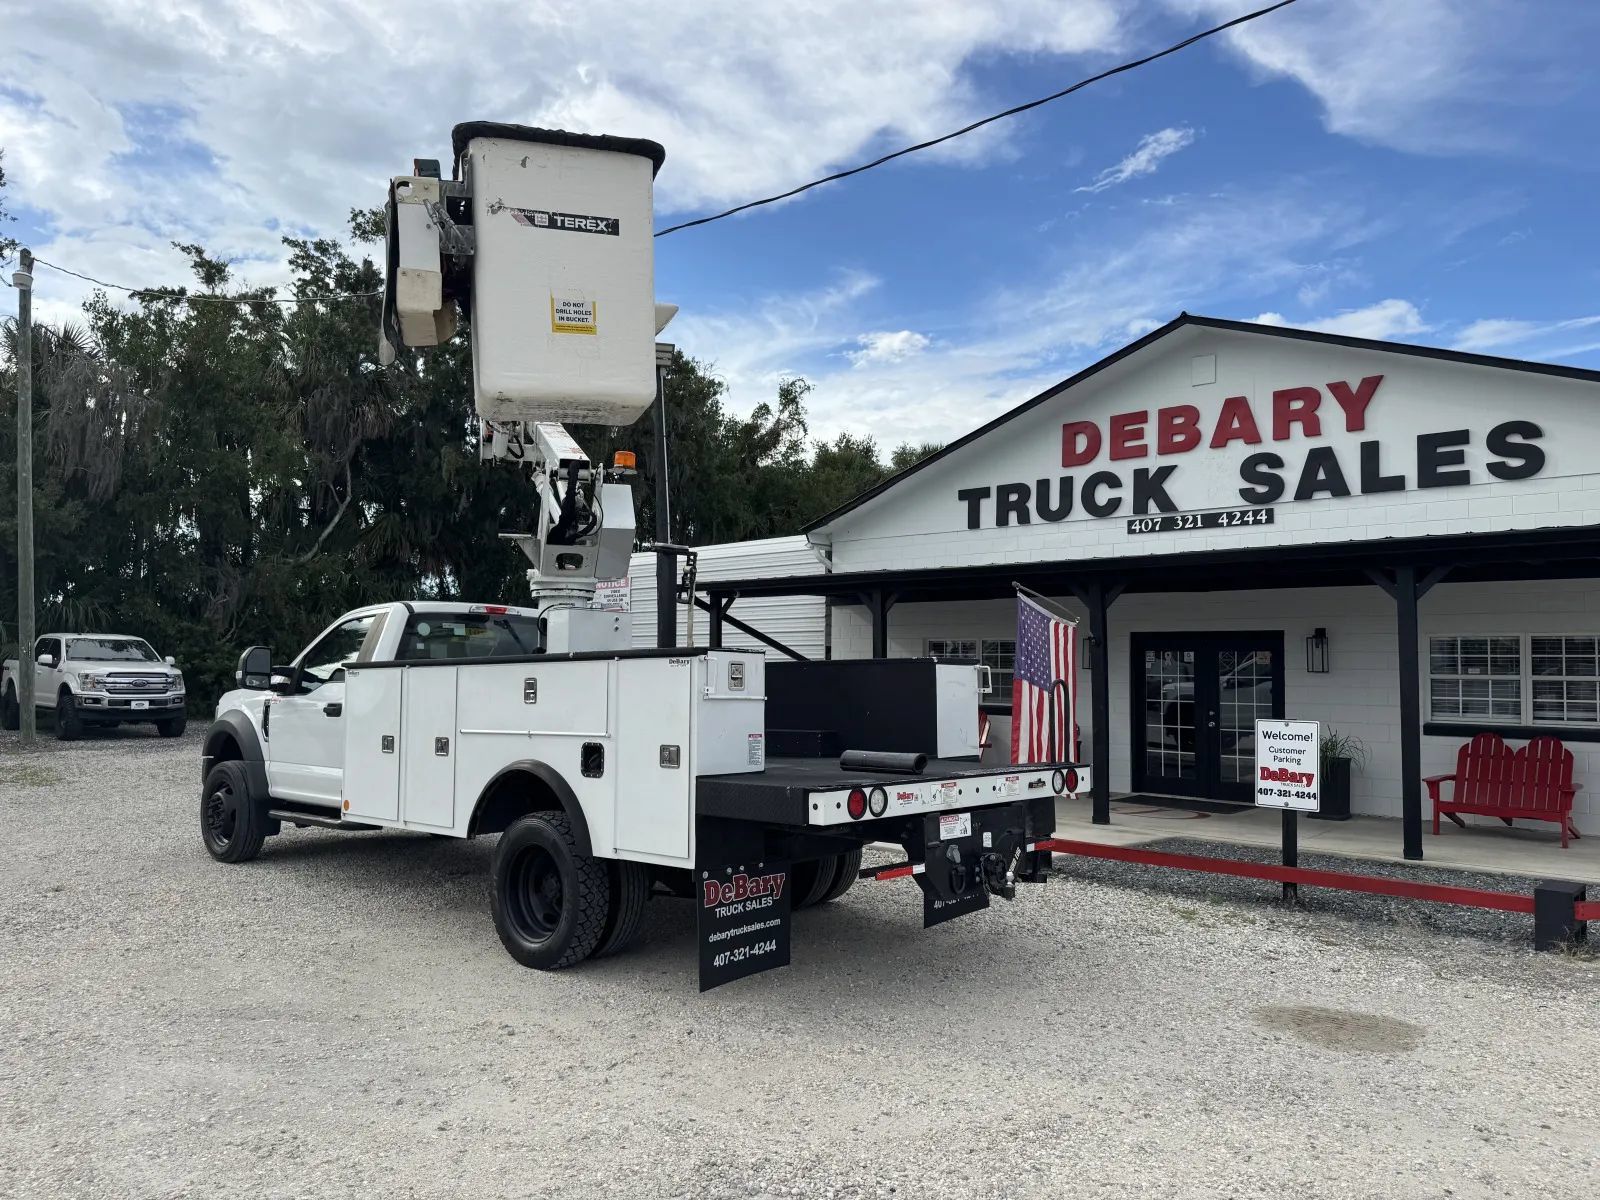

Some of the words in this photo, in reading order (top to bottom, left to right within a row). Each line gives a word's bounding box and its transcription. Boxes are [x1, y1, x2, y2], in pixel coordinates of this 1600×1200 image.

[554, 215, 607, 231] TEREX
[1062, 375, 1384, 467] DEBARY
[958, 464, 1179, 529] TRUCK
[1239, 420, 1546, 504] SALES
[1131, 517, 1161, 533] 407
[1174, 514, 1203, 530] 321
[1218, 508, 1267, 527] 4244
[1262, 730, 1313, 742] Welcome!
[1268, 746, 1306, 755] Customer
[1273, 755, 1301, 765] Parking
[1260, 767, 1314, 787] DeBary
[1258, 788, 1317, 800] 407-321-4244
[704, 873, 785, 908] DeBary
[715, 902, 744, 918] TRUCK
[745, 896, 773, 911] SALES
[709, 918, 780, 943] debarytrucksales.com
[713, 939, 777, 967] 407-321-4244
